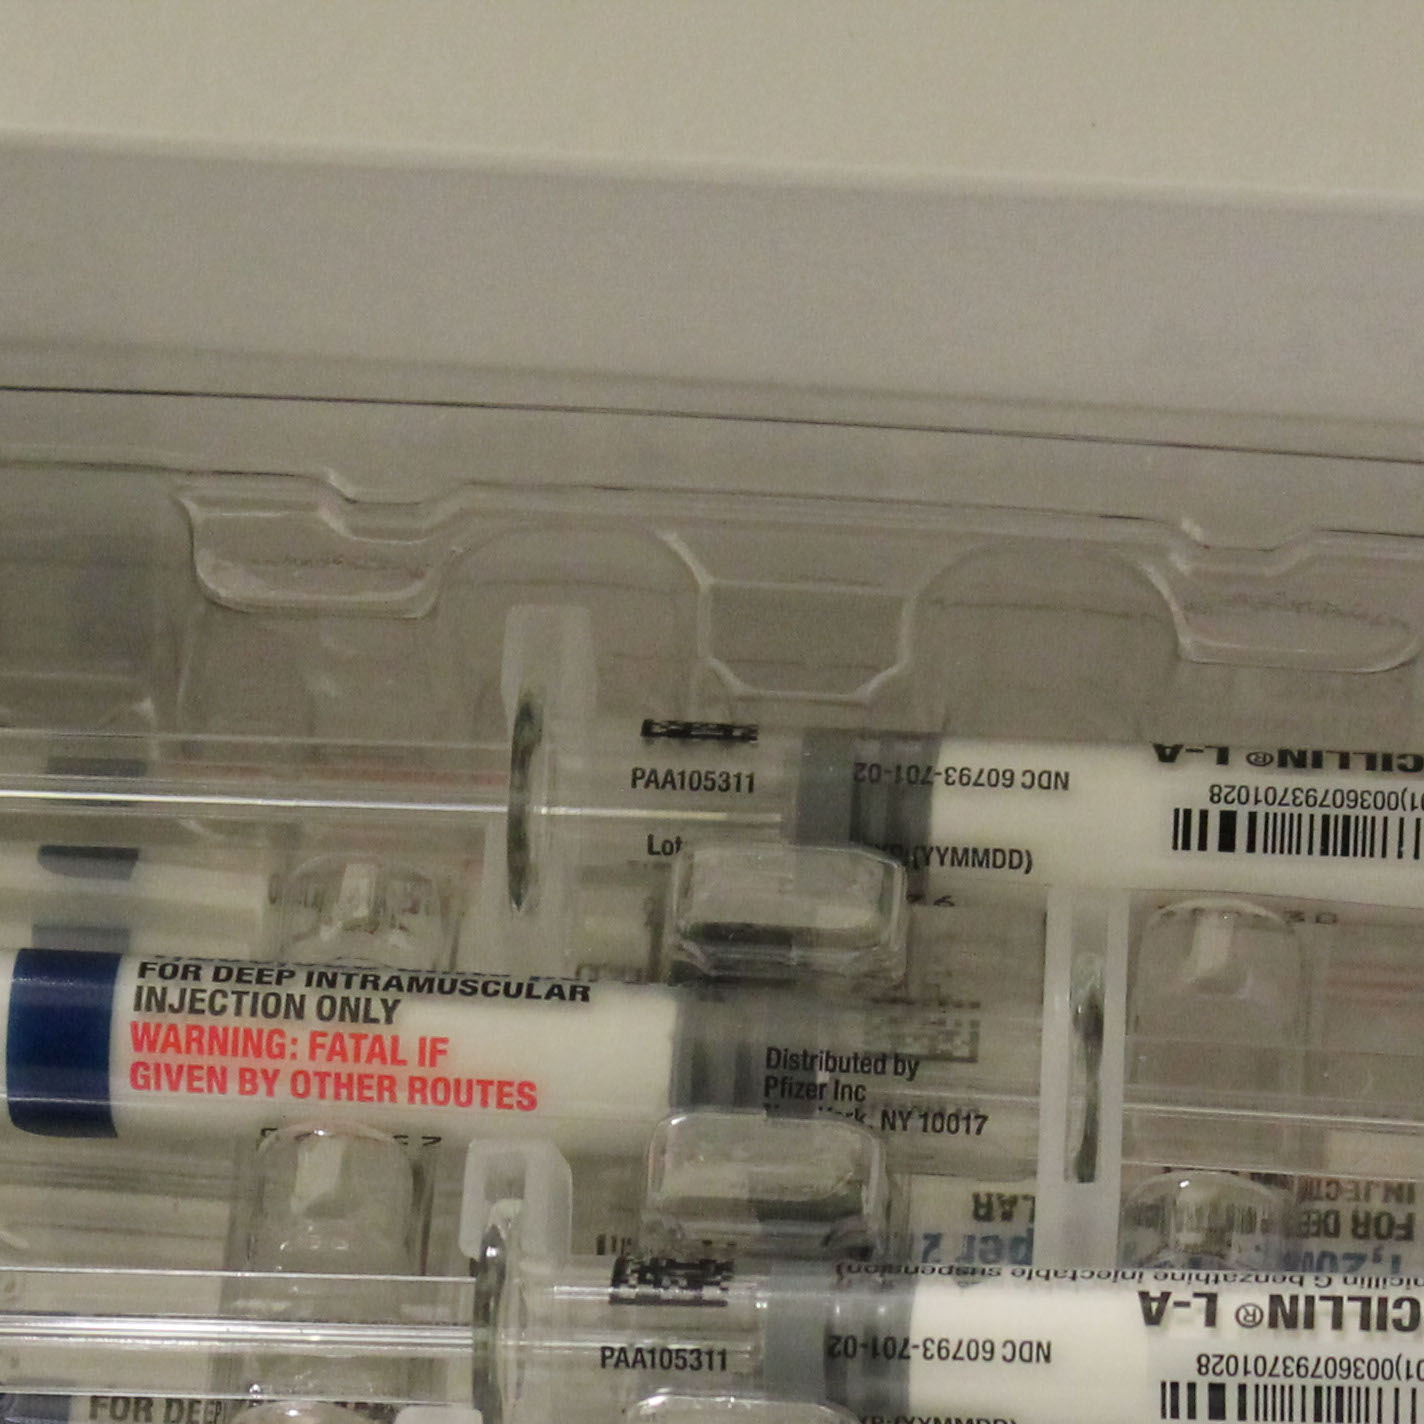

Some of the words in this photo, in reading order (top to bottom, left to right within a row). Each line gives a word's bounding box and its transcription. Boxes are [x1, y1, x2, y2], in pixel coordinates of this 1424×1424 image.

[631, 767, 755, 793] PAA105311
[854, 762, 1015, 790] 60793-701-02
[1021, 770, 1070, 792] NDC
[137, 961, 202, 984] FOR
[212, 965, 296, 987] DEEP
[304, 971, 592, 1003] INTRAMUSCULAR
[133, 985, 307, 1022] INJECTION
[315, 994, 402, 1026] ONLY
[129, 1021, 298, 1060] WARNING:
[308, 1030, 408, 1067] FATAL
[417, 1036, 450, 1068] IF
[765, 1047, 886, 1076] Distributed
[893, 1055, 920, 1082] by
[128, 1061, 228, 1094] GIVEN
[238, 1067, 281, 1097] BY
[289, 1069, 398, 1102] OTHER
[407, 1075, 538, 1112] ROUTES
[763, 1075, 828, 1101] Pfizer
[833, 1079, 866, 1102] Inc
[880, 1109, 915, 1132] NY
[919, 1111, 989, 1136] 10017
[1350, 1210, 1414, 1242] FOR
[1138, 1289, 1219, 1328] L-A
[599, 1345, 728, 1372] PAA105311
[828, 1334, 996, 1362] 60793-701-02
[1002, 1341, 1052, 1364] NDC
